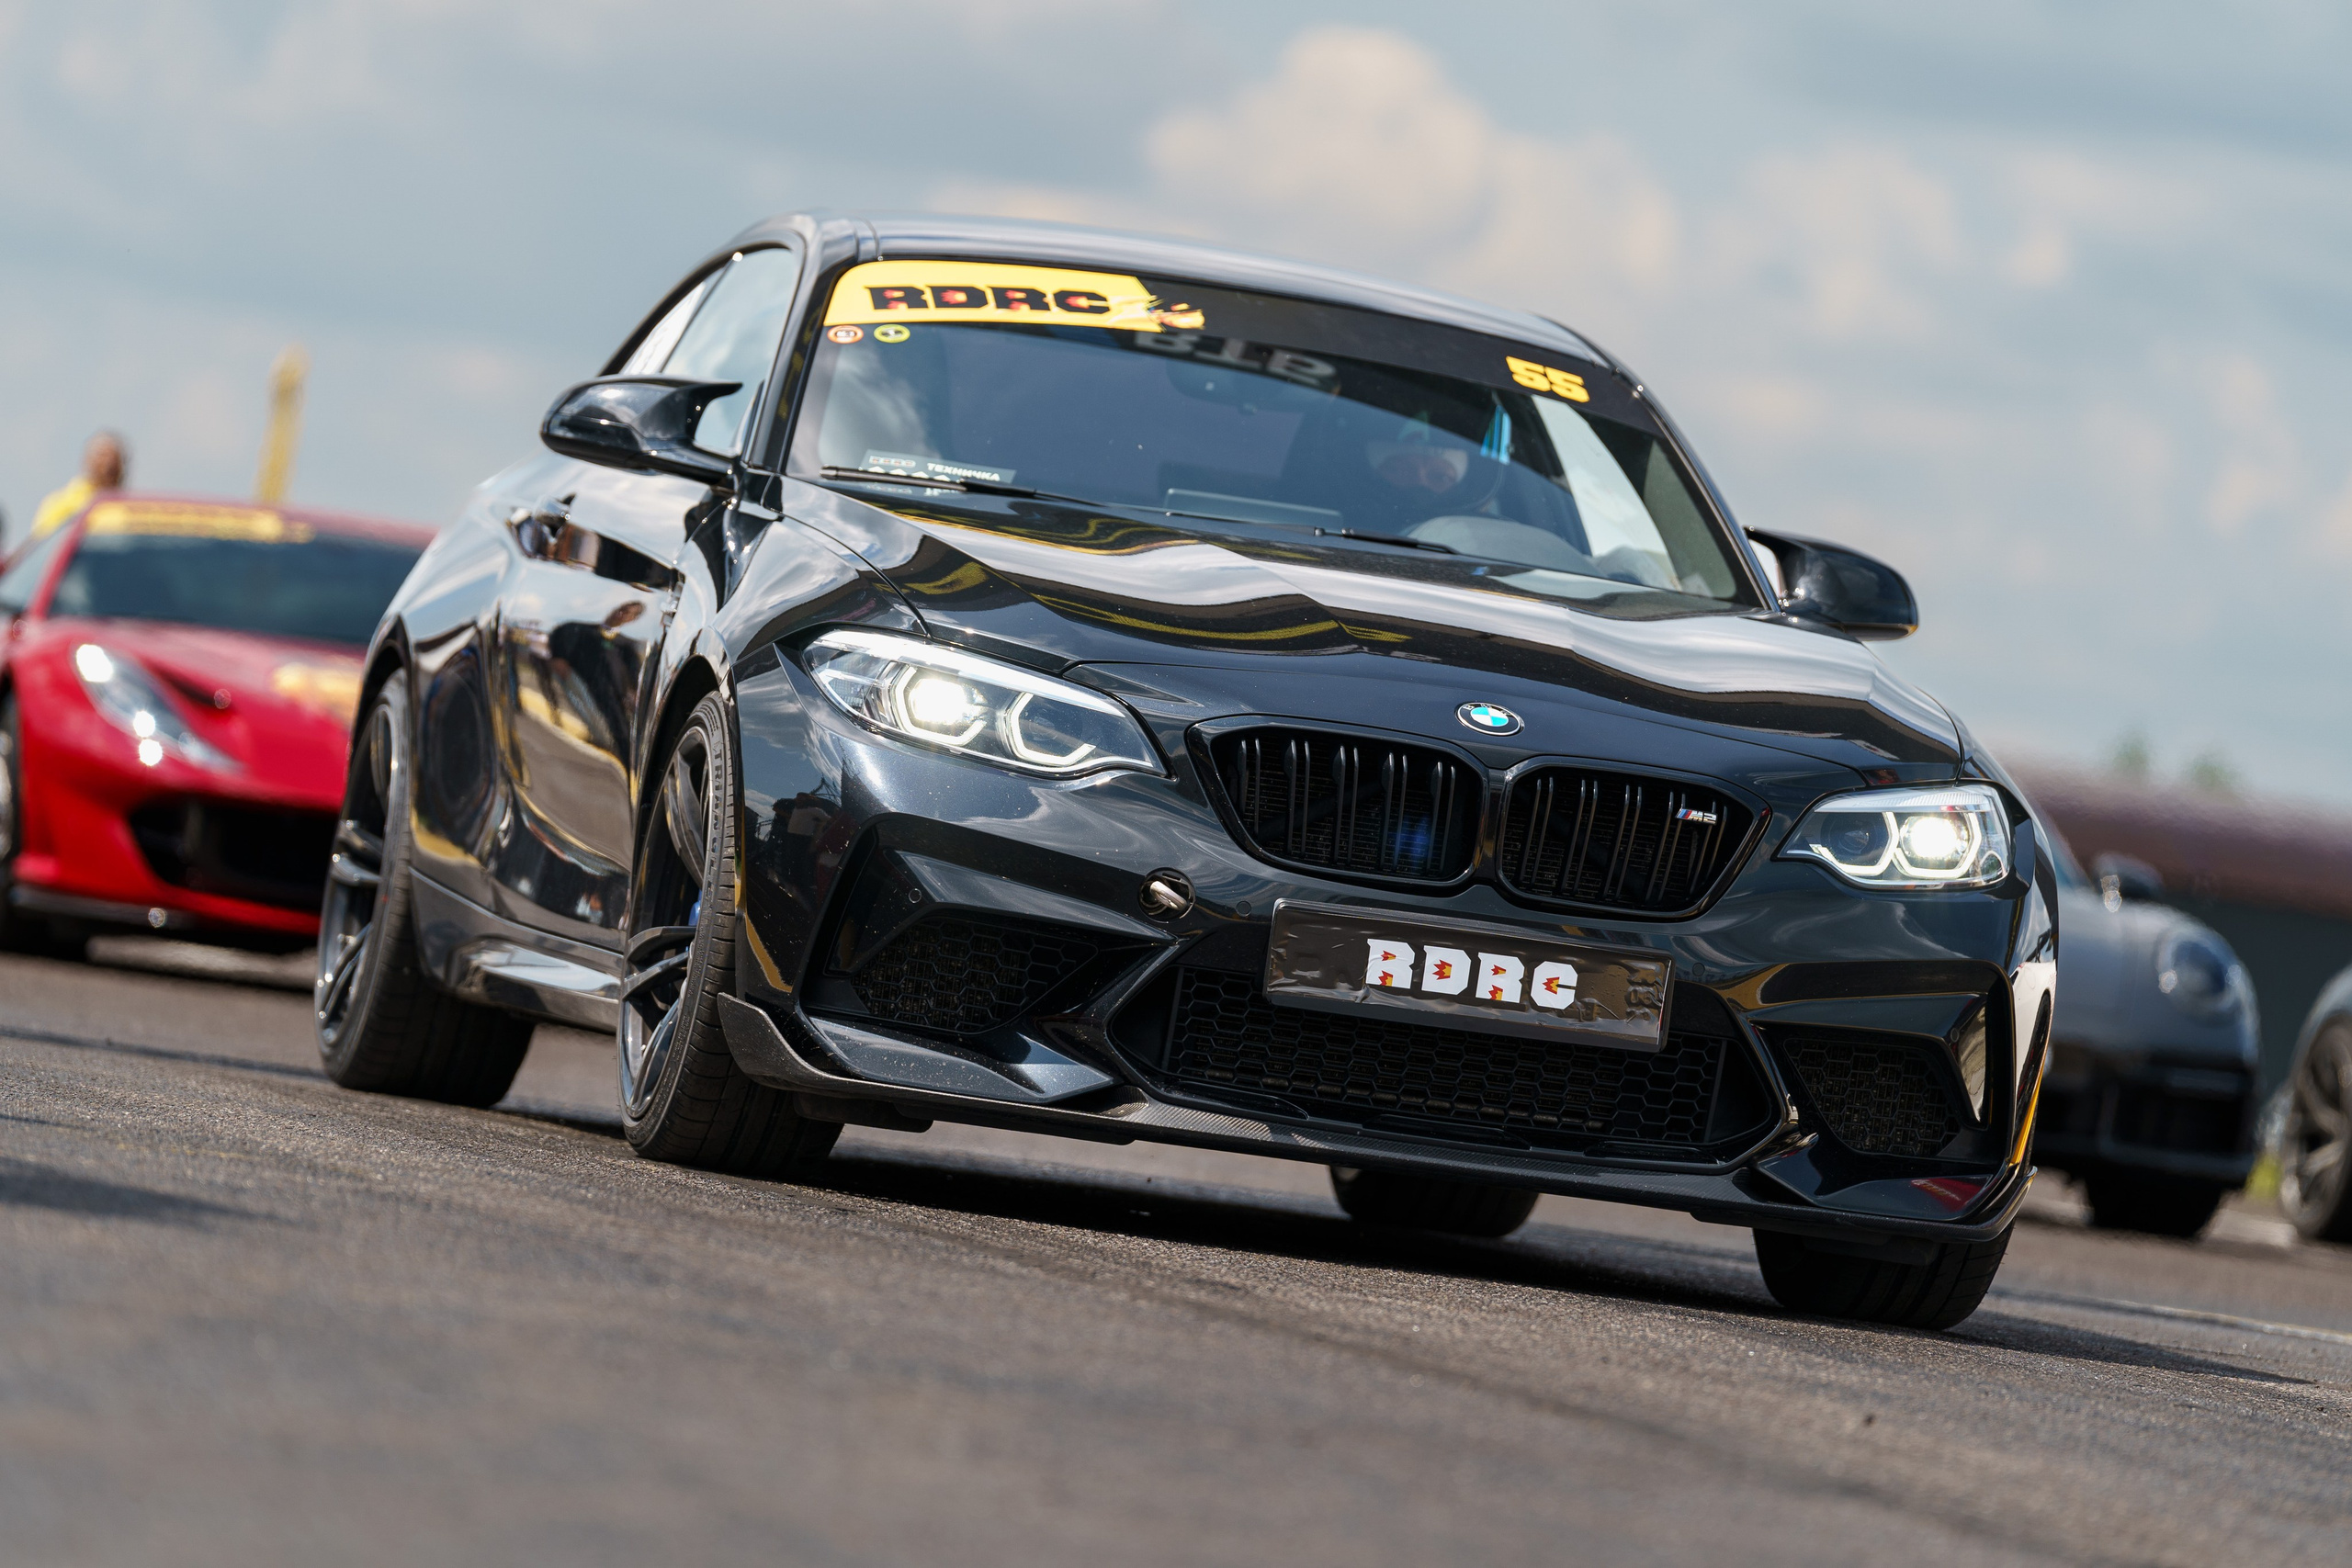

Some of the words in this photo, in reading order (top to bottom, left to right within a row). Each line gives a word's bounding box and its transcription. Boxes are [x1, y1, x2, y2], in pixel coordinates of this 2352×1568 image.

[864, 286, 1111, 314] RDRC
[1505, 355, 1590, 402] 55
[927, 462, 1001, 481] ТЕХНИЧКА
[705, 749, 724, 901] TRIANGLE
[1689, 809, 1717, 824] M2
[1365, 938, 1578, 1010] RDRC
